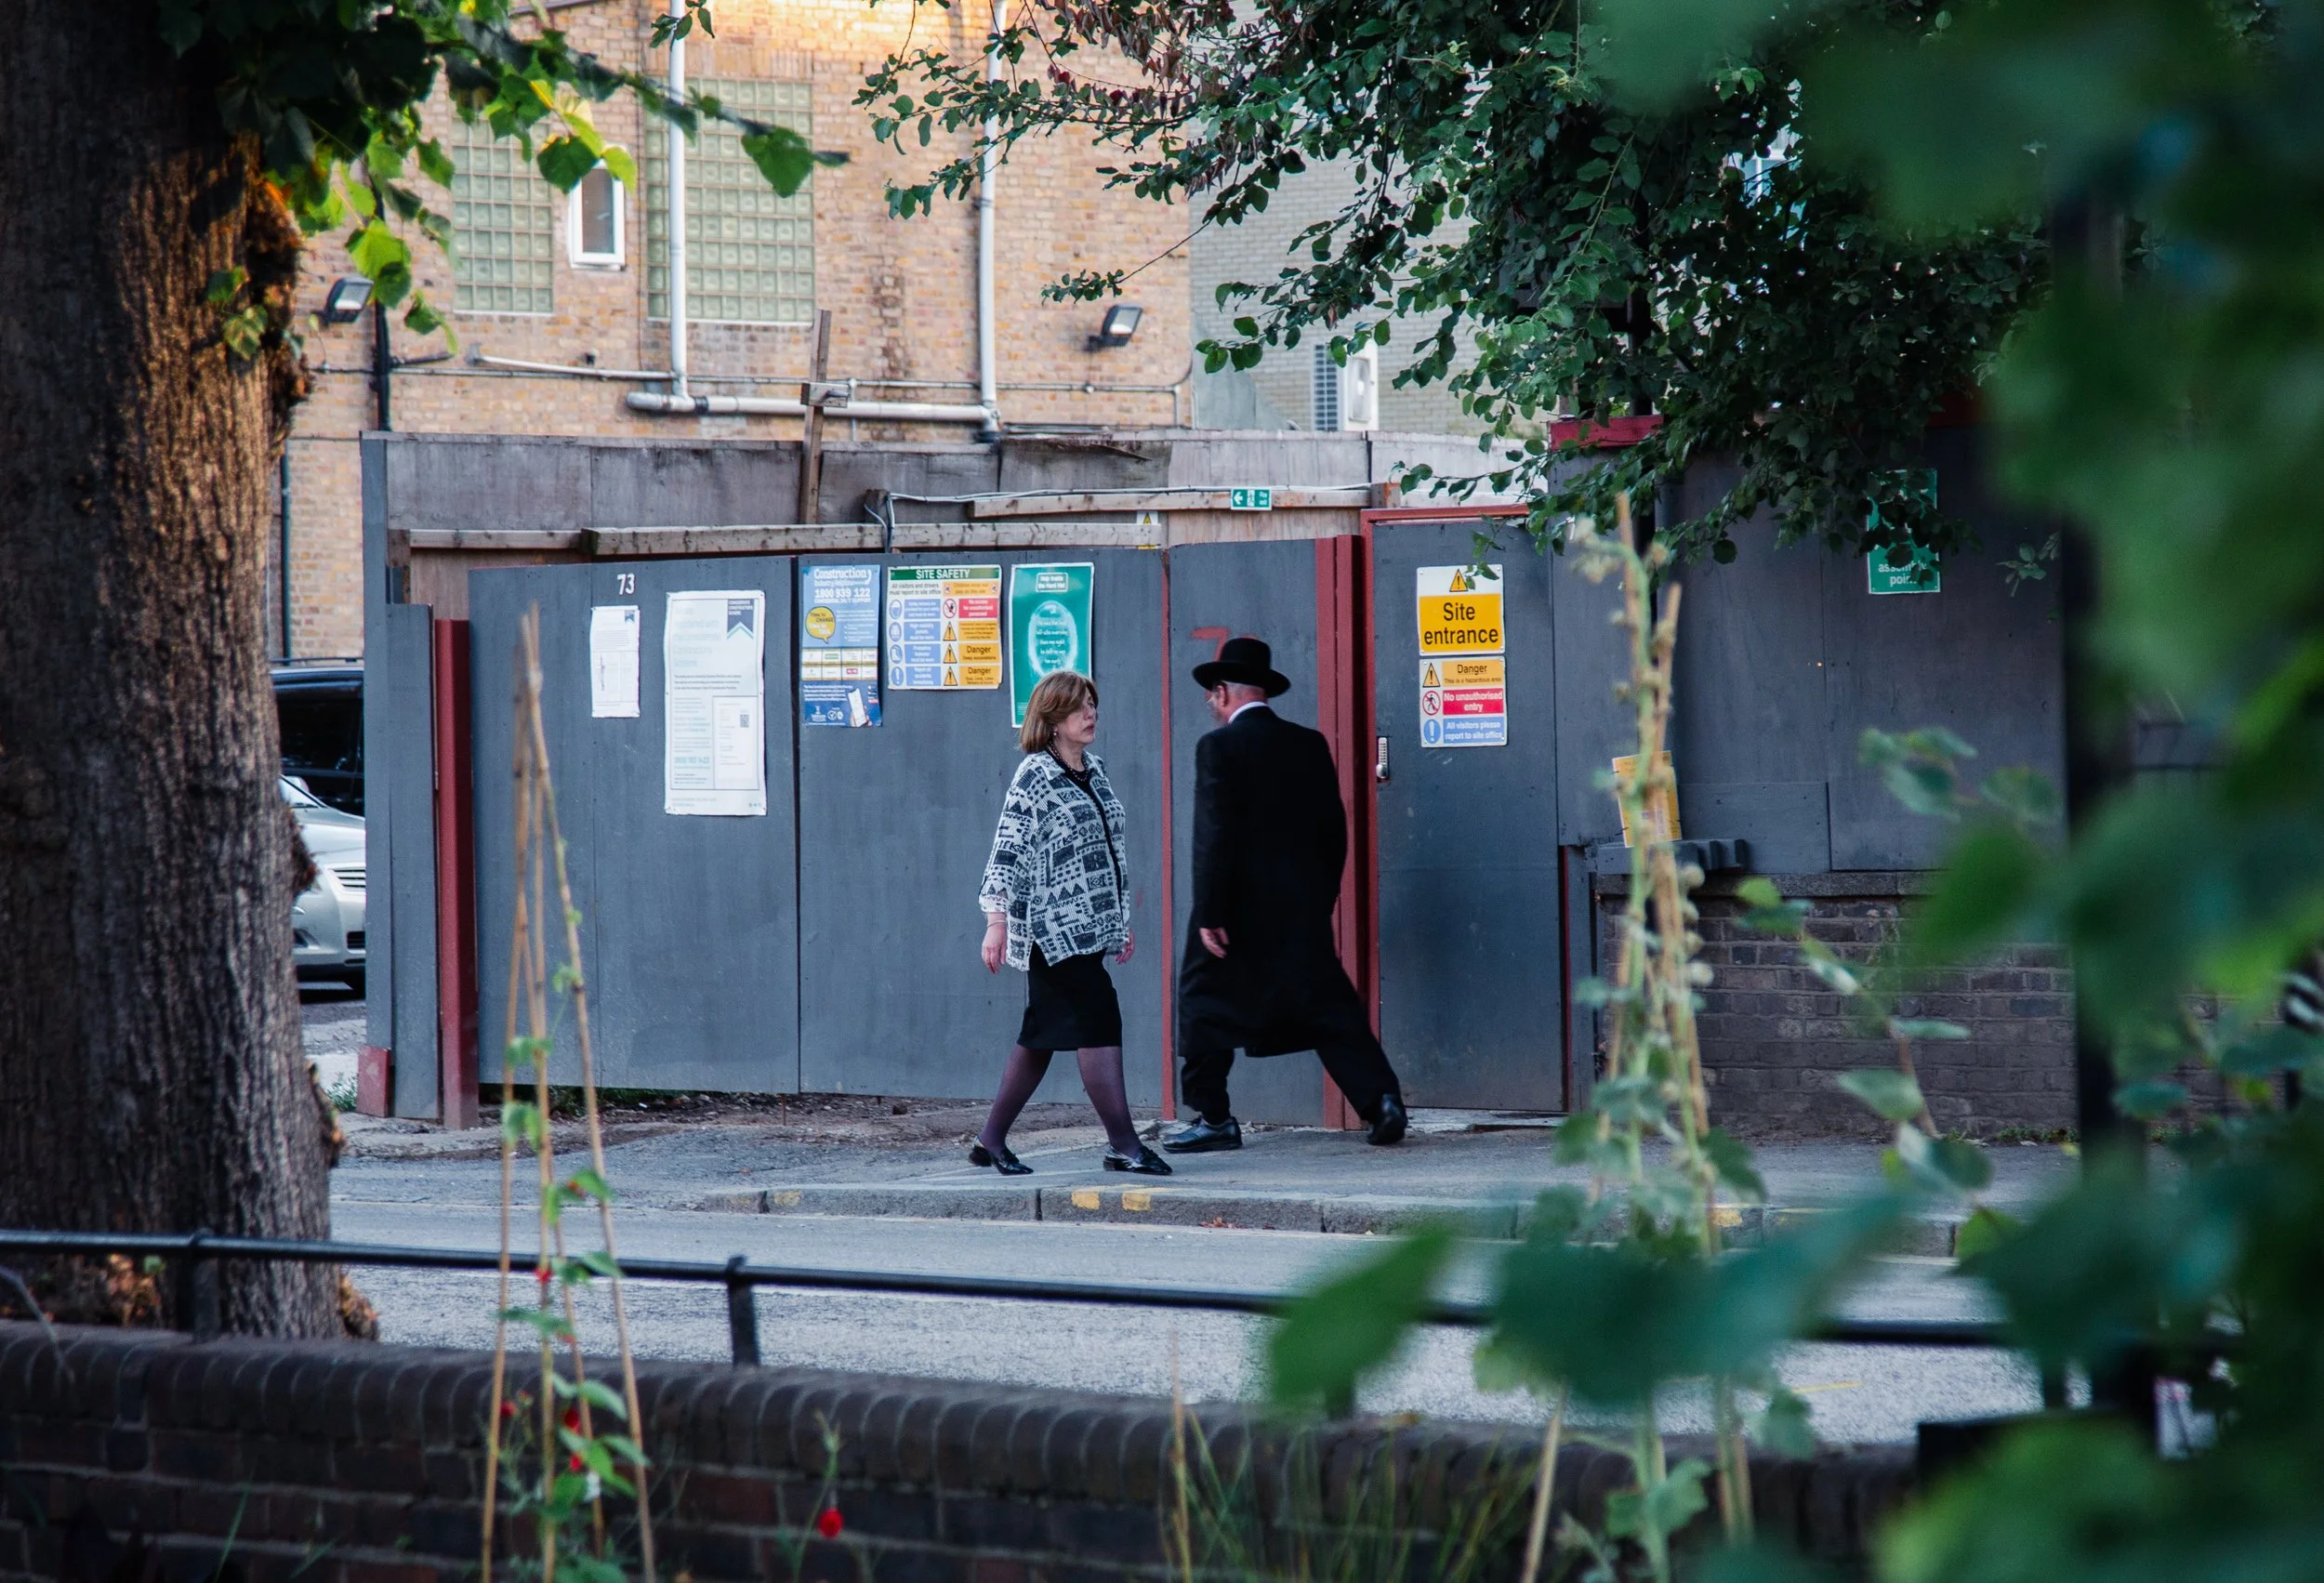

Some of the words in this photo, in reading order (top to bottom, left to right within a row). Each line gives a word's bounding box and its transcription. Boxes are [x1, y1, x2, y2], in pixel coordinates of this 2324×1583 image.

[814, 568, 867, 579] Construction
[916, 569, 934, 579] SITE
[936, 569, 971, 579] SAFETY
[616, 573, 636, 595] 73
[853, 587, 871, 598] 122
[1443, 602, 1475, 621] Site
[1424, 627, 1499, 645] entrance
[967, 646, 991, 654] Danger
[1458, 664, 1487, 675] Danger
[1444, 693, 1454, 701] No
[1456, 691, 1502, 701] unauthorised
[1464, 703, 1484, 712] entry
[1480, 721, 1501, 730] please
[1486, 731, 1502, 739] office
